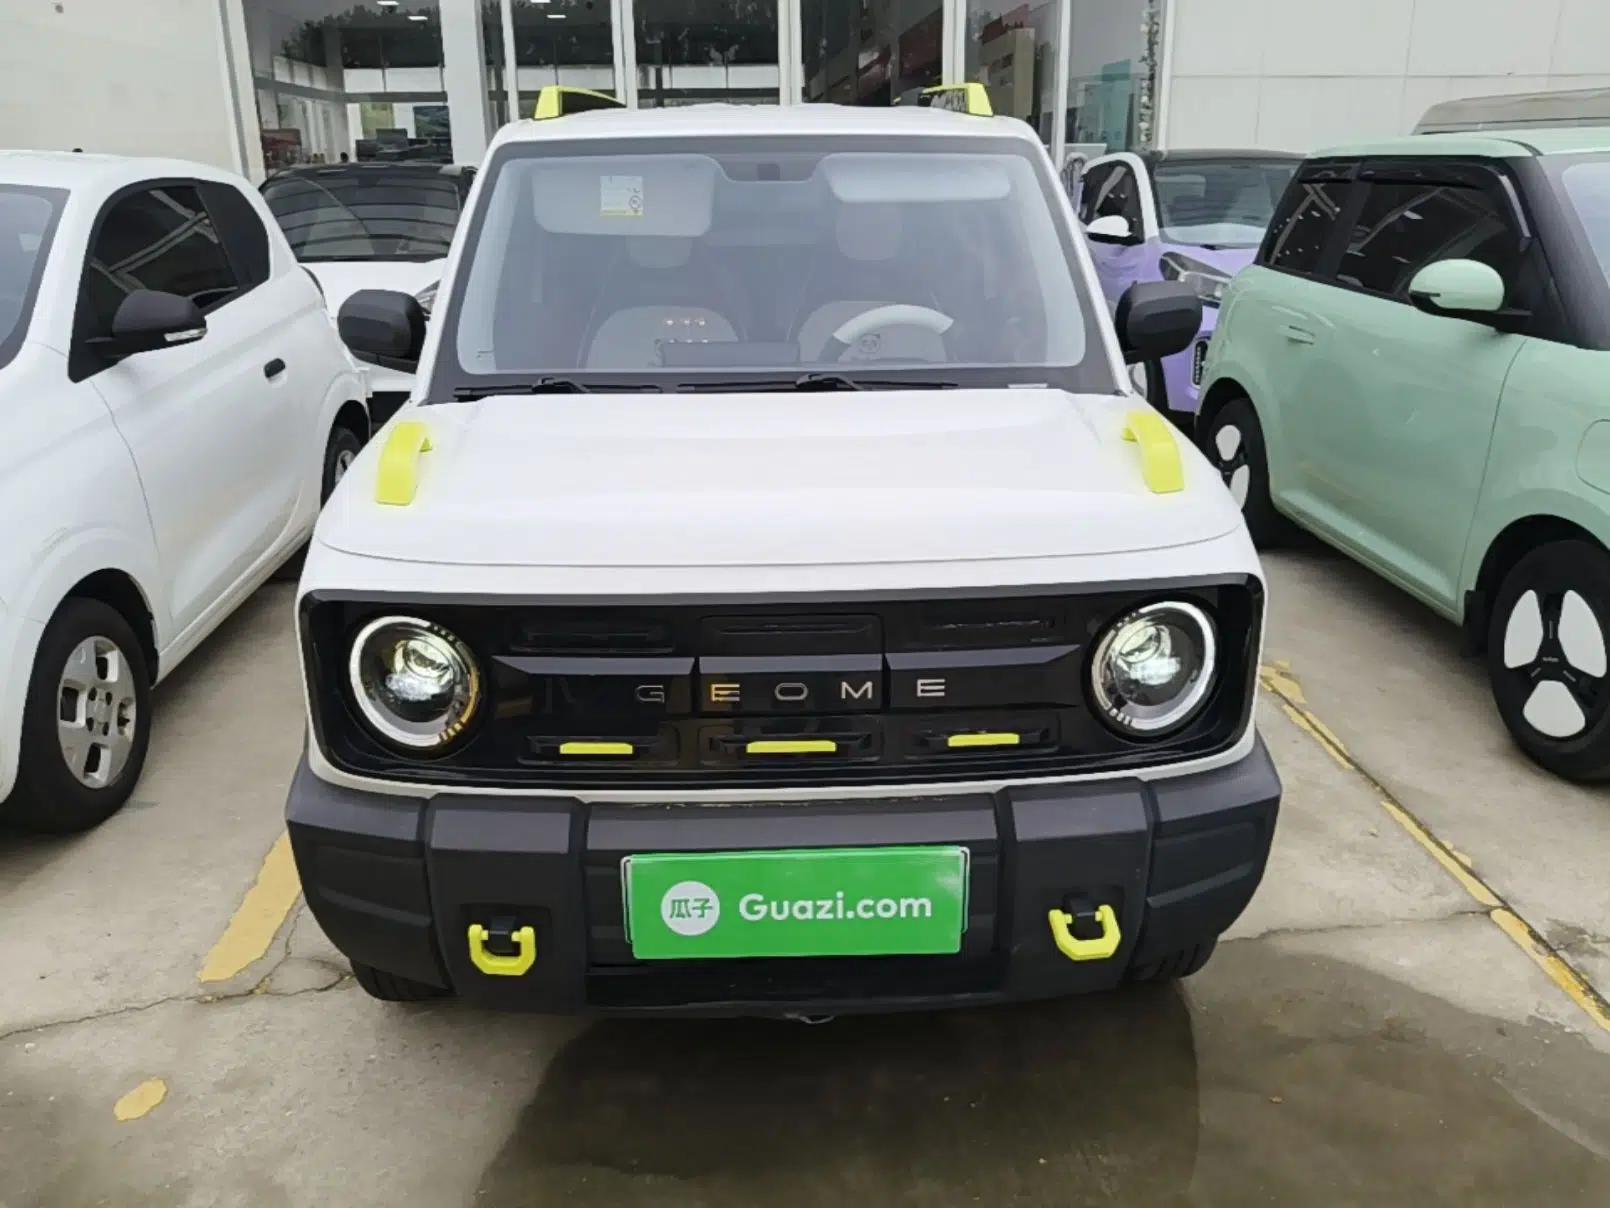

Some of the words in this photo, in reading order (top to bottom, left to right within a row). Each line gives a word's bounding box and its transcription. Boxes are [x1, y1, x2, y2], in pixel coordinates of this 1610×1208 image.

[635, 679, 946, 703] GEOME
[669, 897, 713, 920] 瓜子
[738, 891, 933, 921] Guazi.com
